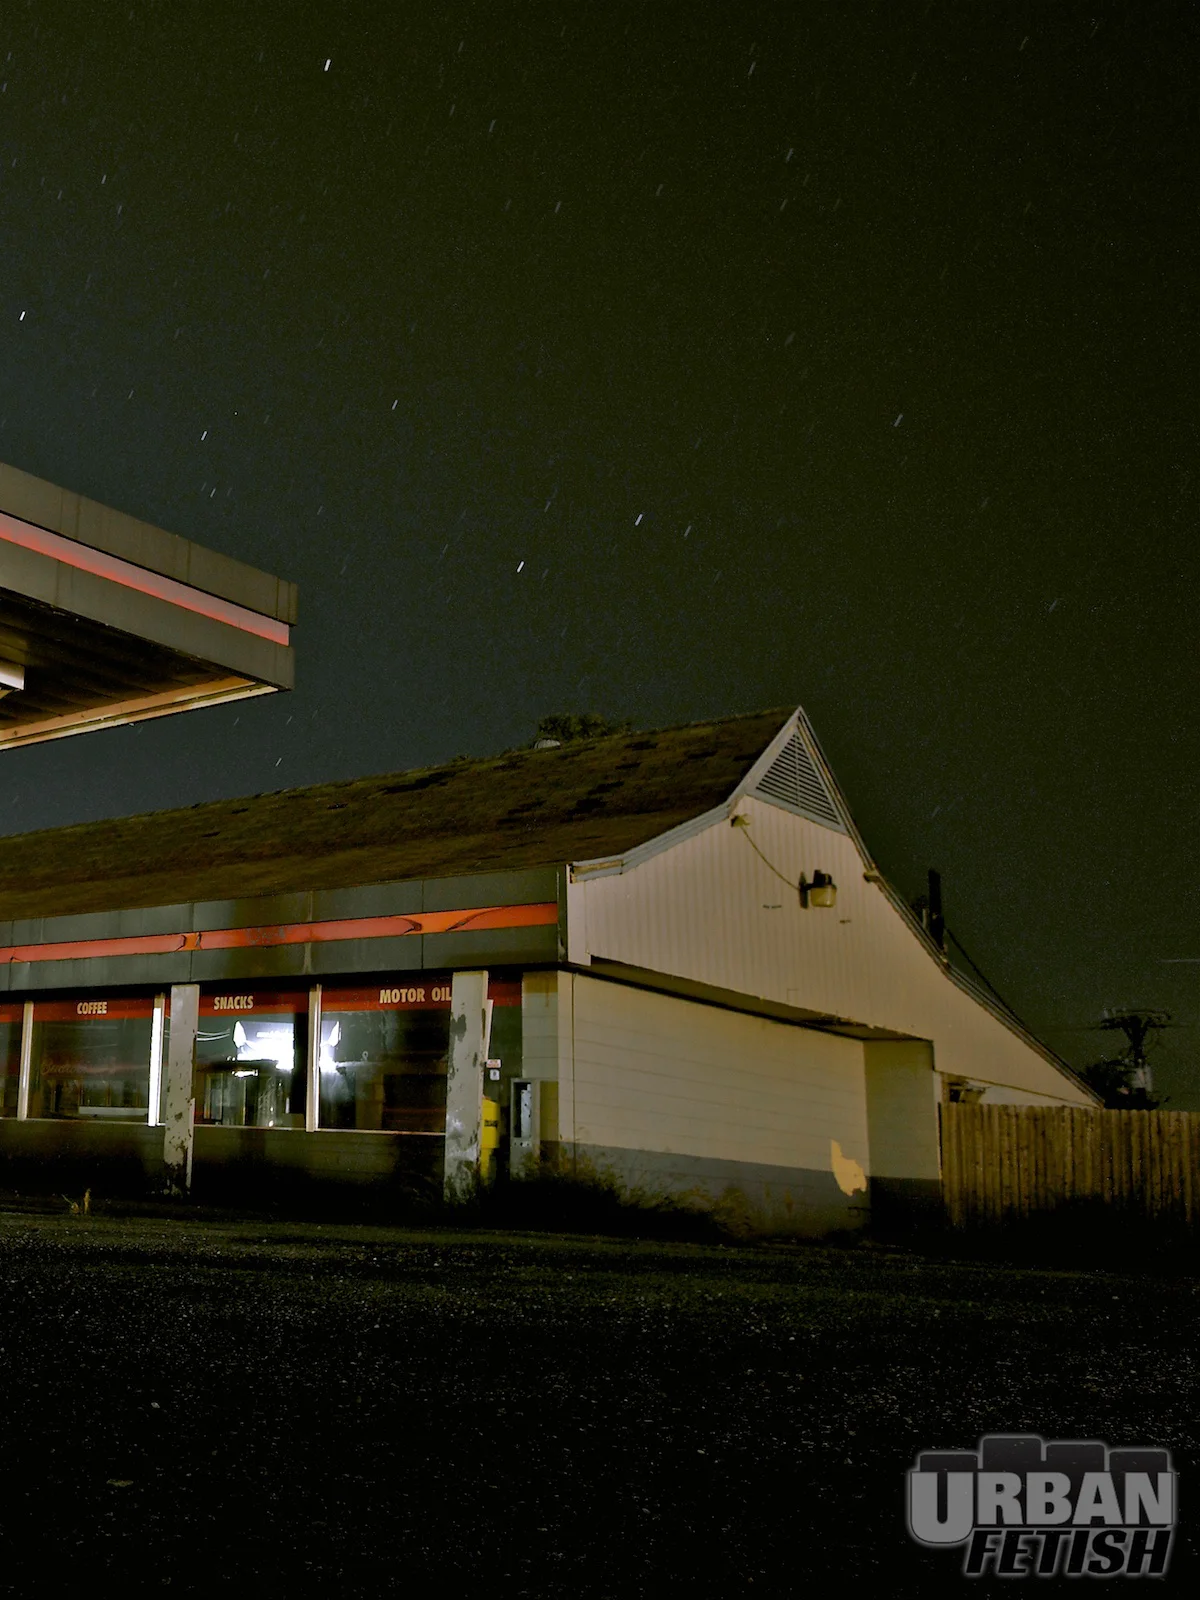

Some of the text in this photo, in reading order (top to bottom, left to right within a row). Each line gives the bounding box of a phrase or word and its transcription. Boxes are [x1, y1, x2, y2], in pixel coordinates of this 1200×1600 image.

[213, 995, 254, 1010] SNACKS
[379, 986, 452, 1004] MOTOR OIL
[76, 1001, 108, 1015] COFFEE
